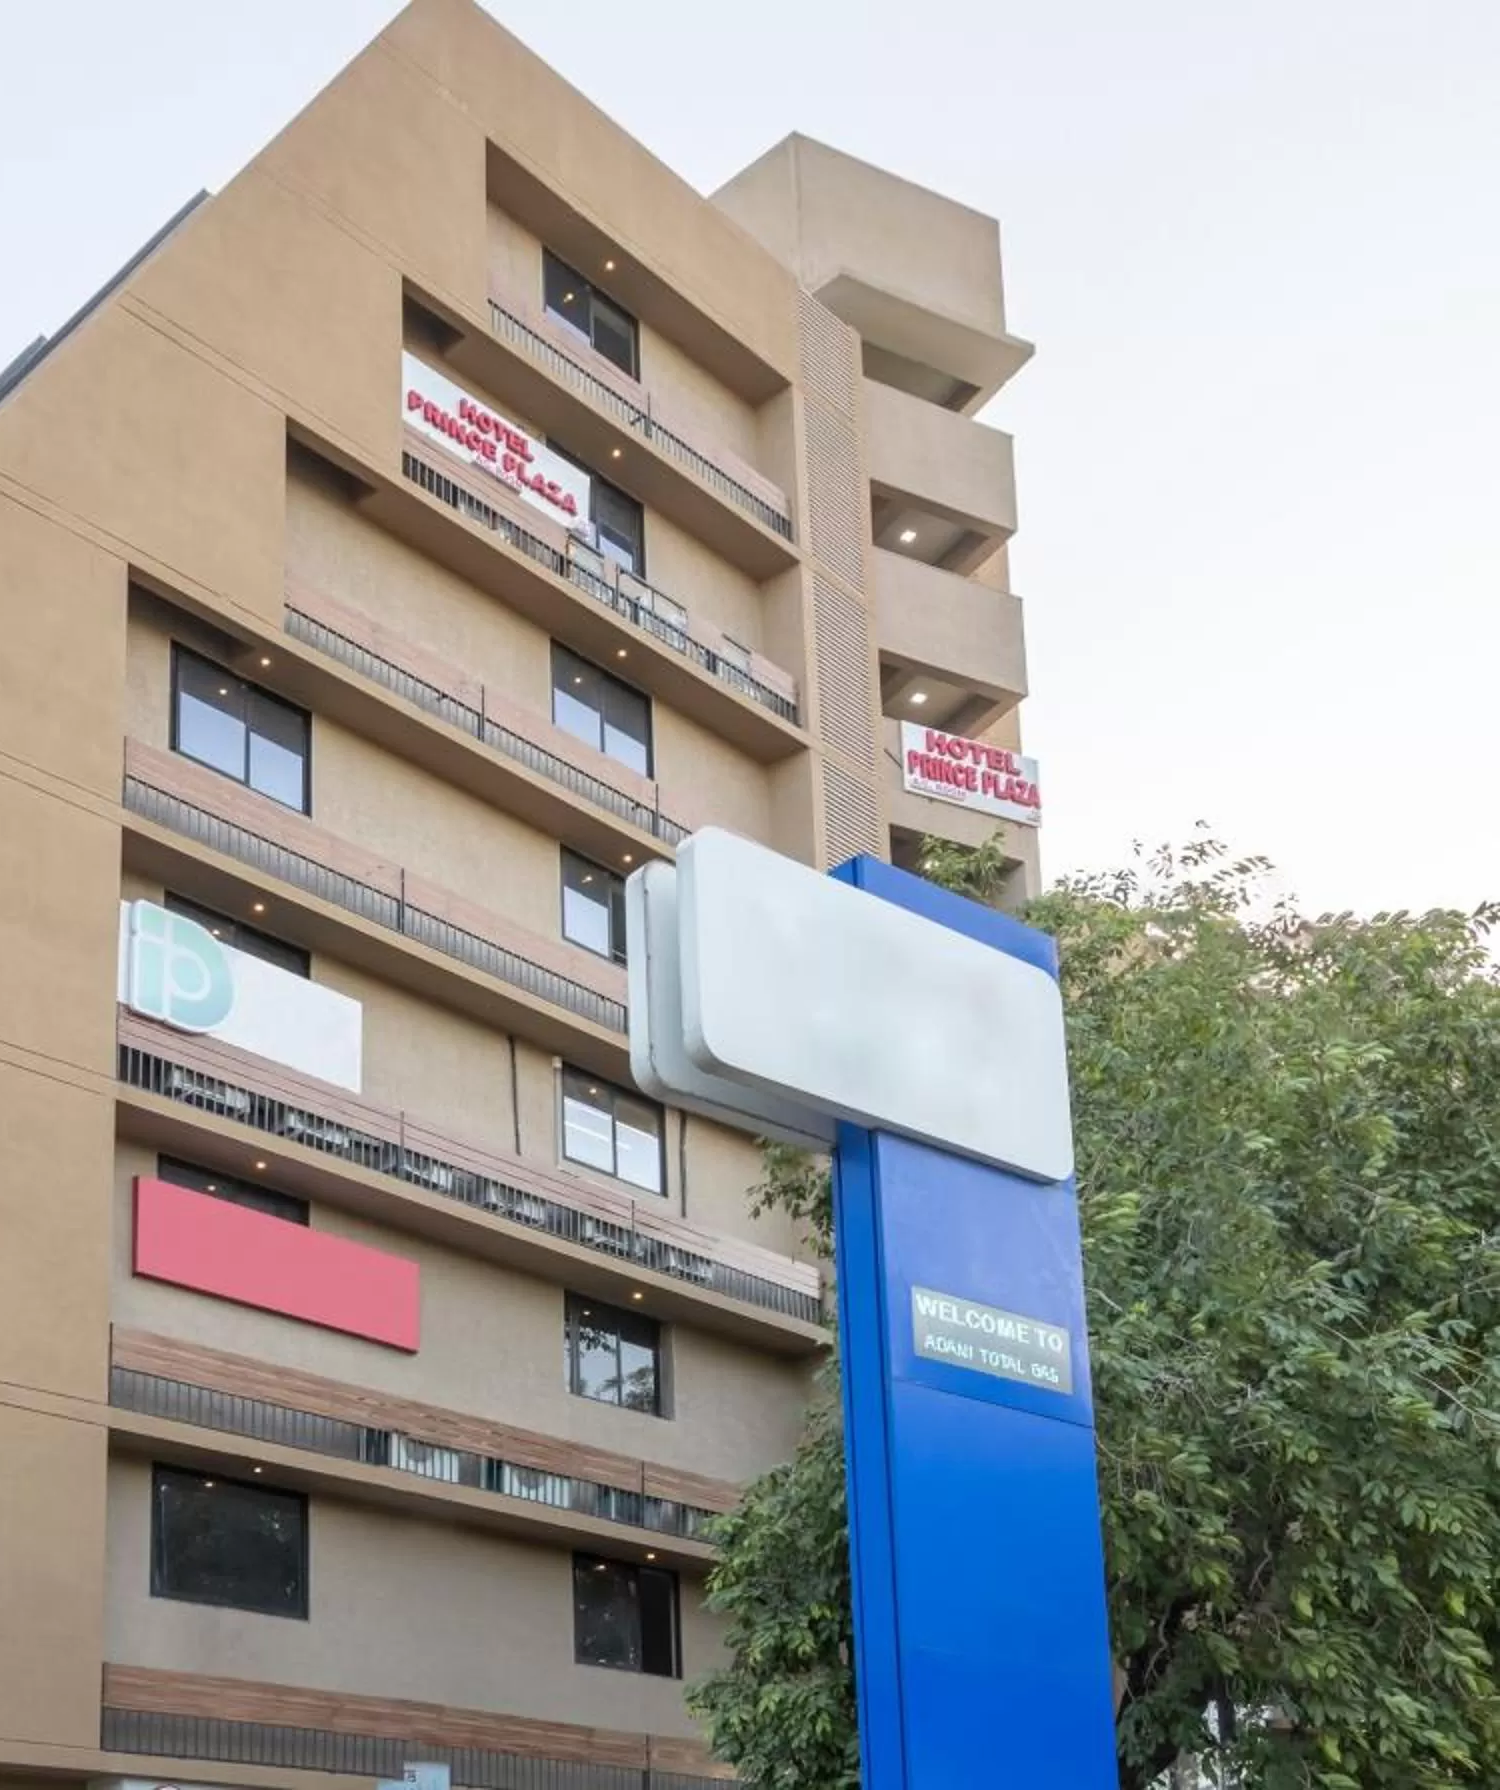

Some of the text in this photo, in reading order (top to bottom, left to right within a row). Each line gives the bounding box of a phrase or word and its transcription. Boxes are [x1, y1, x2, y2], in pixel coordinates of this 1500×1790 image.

[407, 389, 497, 463] PRINCE
[502, 452, 578, 517] PLAZA
[459, 397, 534, 462] HOTEL
[907, 749, 978, 792] PRINCE
[981, 769, 1041, 809] PLAZA
[925, 729, 1022, 776] HOTEL
[915, 1293, 1063, 1353] WELCOME TO
